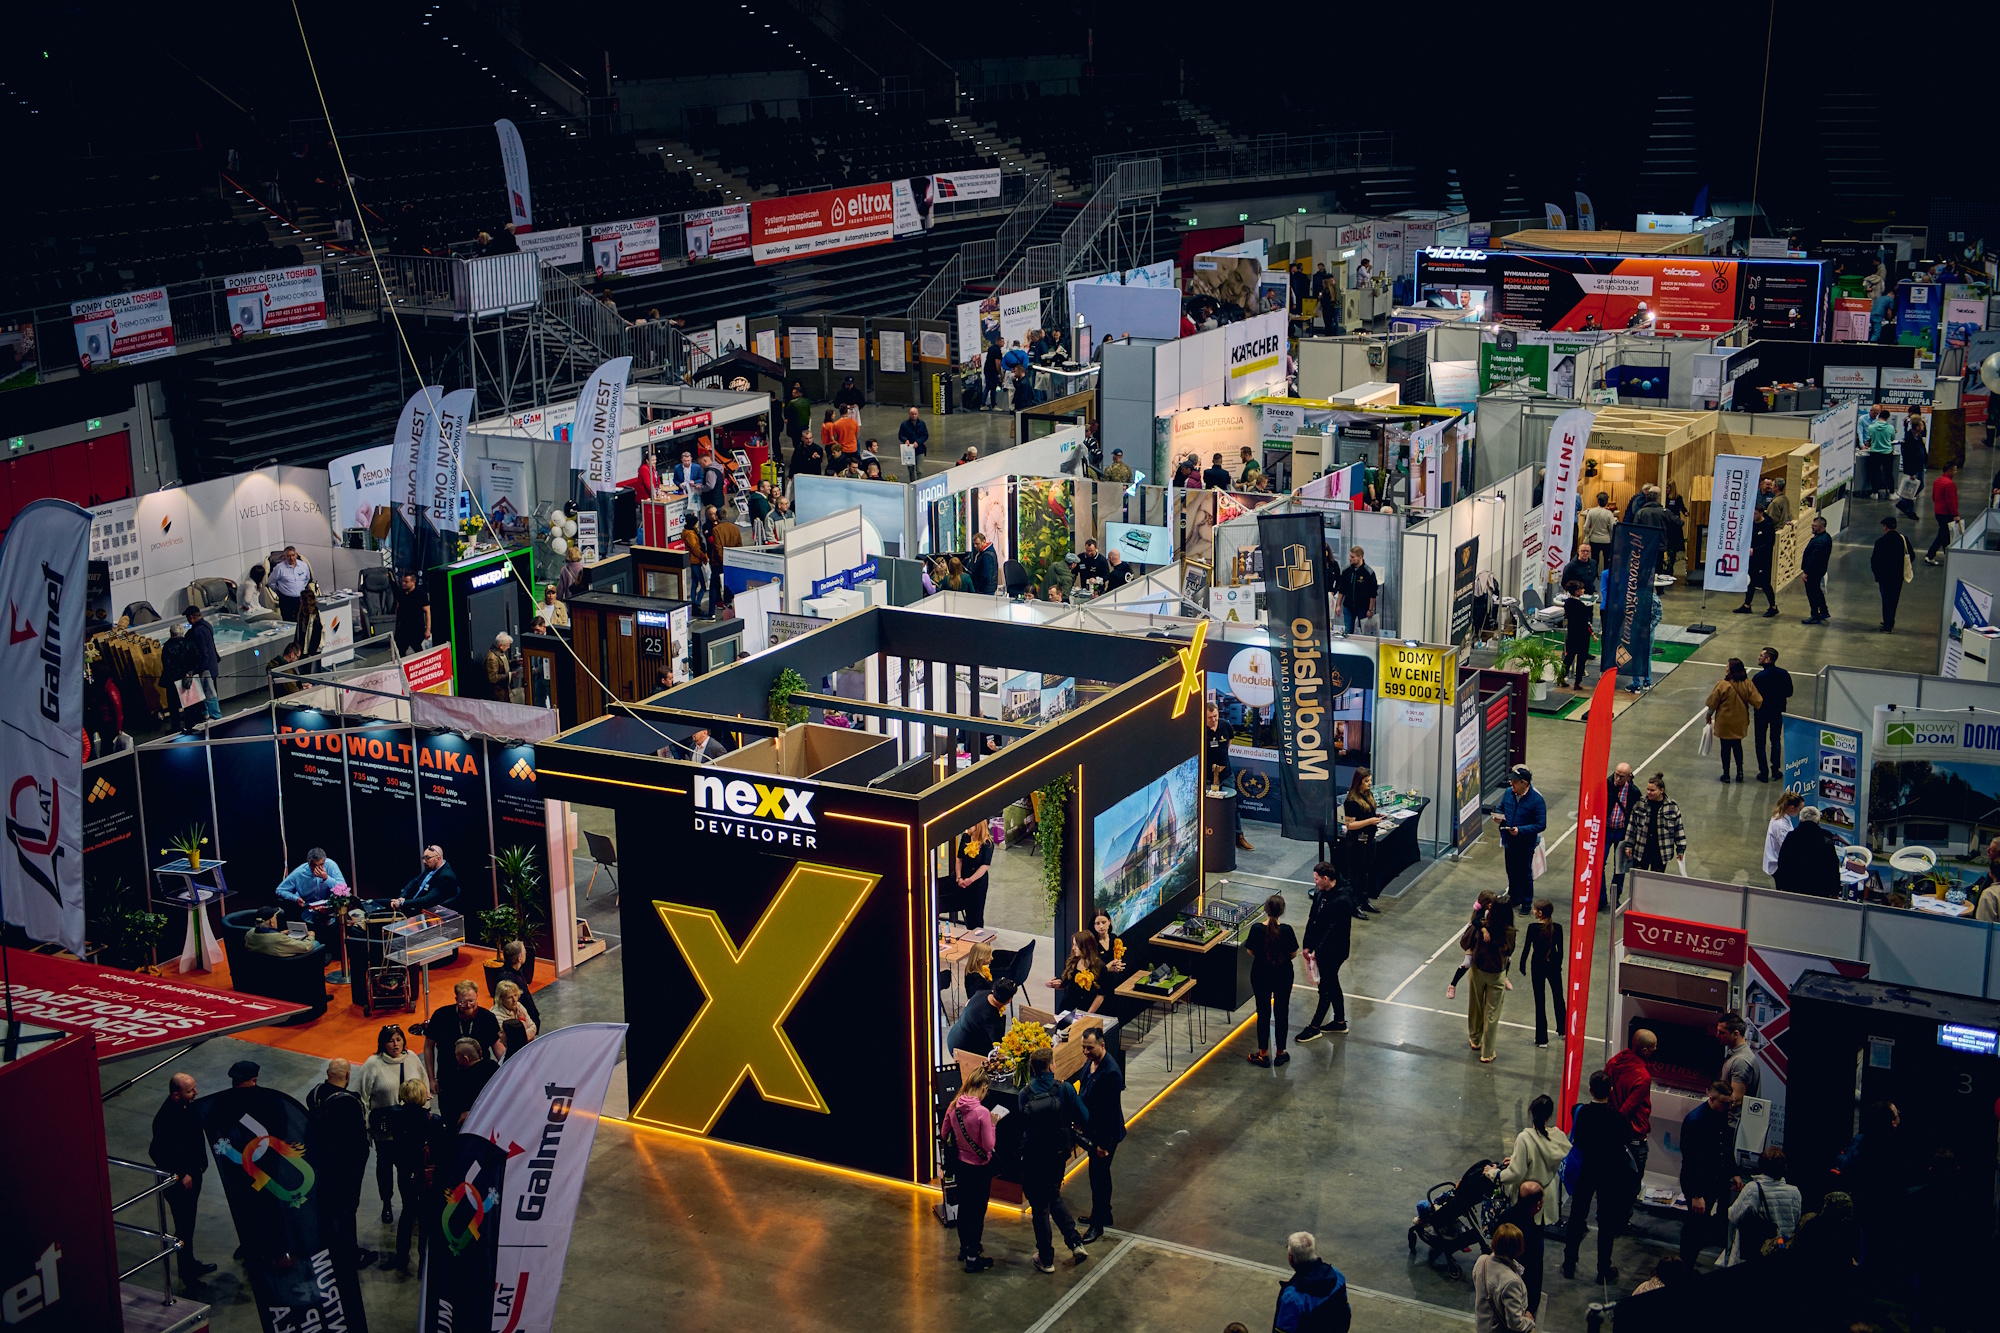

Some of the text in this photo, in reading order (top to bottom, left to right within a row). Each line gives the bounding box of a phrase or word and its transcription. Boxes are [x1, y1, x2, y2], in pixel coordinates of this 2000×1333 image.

[848, 193, 892, 216] eltrox
[687, 206, 745, 220] POMPY CIEPŁA TOSHIBA
[764, 208, 819, 225] Systemy zabezpieczeń
[864, 212, 892, 222] bezpieczniej
[594, 220, 656, 234] POMPY CIEPŁA TOSHIBA
[768, 220, 822, 234] możliwym montażem
[766, 245, 790, 255] Monitoring
[828, 237, 840, 245] Home
[845, 233, 869, 242] Automatyka
[870, 229, 889, 238] bramowa
[1341, 226, 1371, 245] INSTALACJE
[230, 268, 317, 287] POMPY CIEPŁA TOSHIBA
[1663, 267, 1701, 277] biotop
[241, 284, 266, 293] DOTACJAMI
[272, 290, 318, 302] THERMO CONTROLS
[76, 291, 163, 314] POMPY CIEPŁA TOSHIBA
[88, 311, 113, 320] DOTACJAMI
[119, 315, 164, 329] THERMO CONTROLS
[1231, 335, 1279, 364] KÄRCHER
[1490, 354, 1524, 363] Fotowoltaika
[1490, 364, 1507, 373] Pompy
[593, 378, 612, 434] INVEST
[608, 382, 620, 428] BUDOWANIA
[1267, 408, 1294, 417] Breeze
[514, 413, 541, 427] HEGAM
[1198, 417, 1244, 427] REKUPERACJA
[649, 425, 671, 437] HEGAM
[606, 429, 615, 460] JAKOŚĆ
[1425, 438, 1433, 446] EKO
[433, 410, 455, 520] REMO INVEST
[590, 438, 605, 483] REMO
[449, 463, 457, 495] JAKOŚĆ
[1551, 432, 1575, 536] SETTLINE
[1723, 469, 1732, 500] Brukowej
[240, 499, 322, 520] WELLNESS & SPA
[1725, 470, 1743, 550] PROFI-BUD
[151, 534, 184, 552] prowellness
[471, 570, 502, 588] WIKĘD
[858, 567, 871, 577] Dietrich
[826, 578, 839, 588] Dietrich
[1620, 532, 1643, 645] tarasygresowe.pl
[772, 619, 814, 630] ZAREJESTRUJ
[40, 561, 66, 723] Galmet
[645, 637, 662, 653] 25
[409, 653, 442, 672] KLIMATYZATORY
[1398, 651, 1433, 665] DOMY
[409, 670, 444, 687] ZEWNĘTRZNEGO
[410, 671, 418, 679] BEZ
[1390, 667, 1441, 683] W CENIE
[1384, 684, 1449, 700] 599 000 ZŁ
[1917, 723, 1955, 734] NOWY
[1836, 741, 1855, 750] DOM
[1916, 733, 1954, 744] DOM
[281, 725, 478, 776] FOTOWOLTAIKA
[304, 764, 329, 776] 500 kWp
[1786, 756, 1809, 770] Budujemy
[353, 771, 366, 781] 735
[366, 775, 379, 784] kWp
[1794, 768, 1800, 777] od
[386, 777, 411, 790] 350 kWp
[432, 784, 458, 797] 250 kWp
[1803, 780, 1816, 792] lat
[38, 786, 52, 827] LAT
[694, 774, 816, 825] nexx
[695, 818, 818, 849] DEVELOPER
[1632, 921, 1729, 951] ROTENSO
[1706, 948, 1724, 957] better
[68, 984, 140, 1004] CIEPŁA
[99, 972, 244, 1006] Produkujemy Polsce
[1958, 1072, 1973, 1094] 3
[515, 1081, 576, 1221] Galmet
[494, 1283, 514, 1317] LAT
